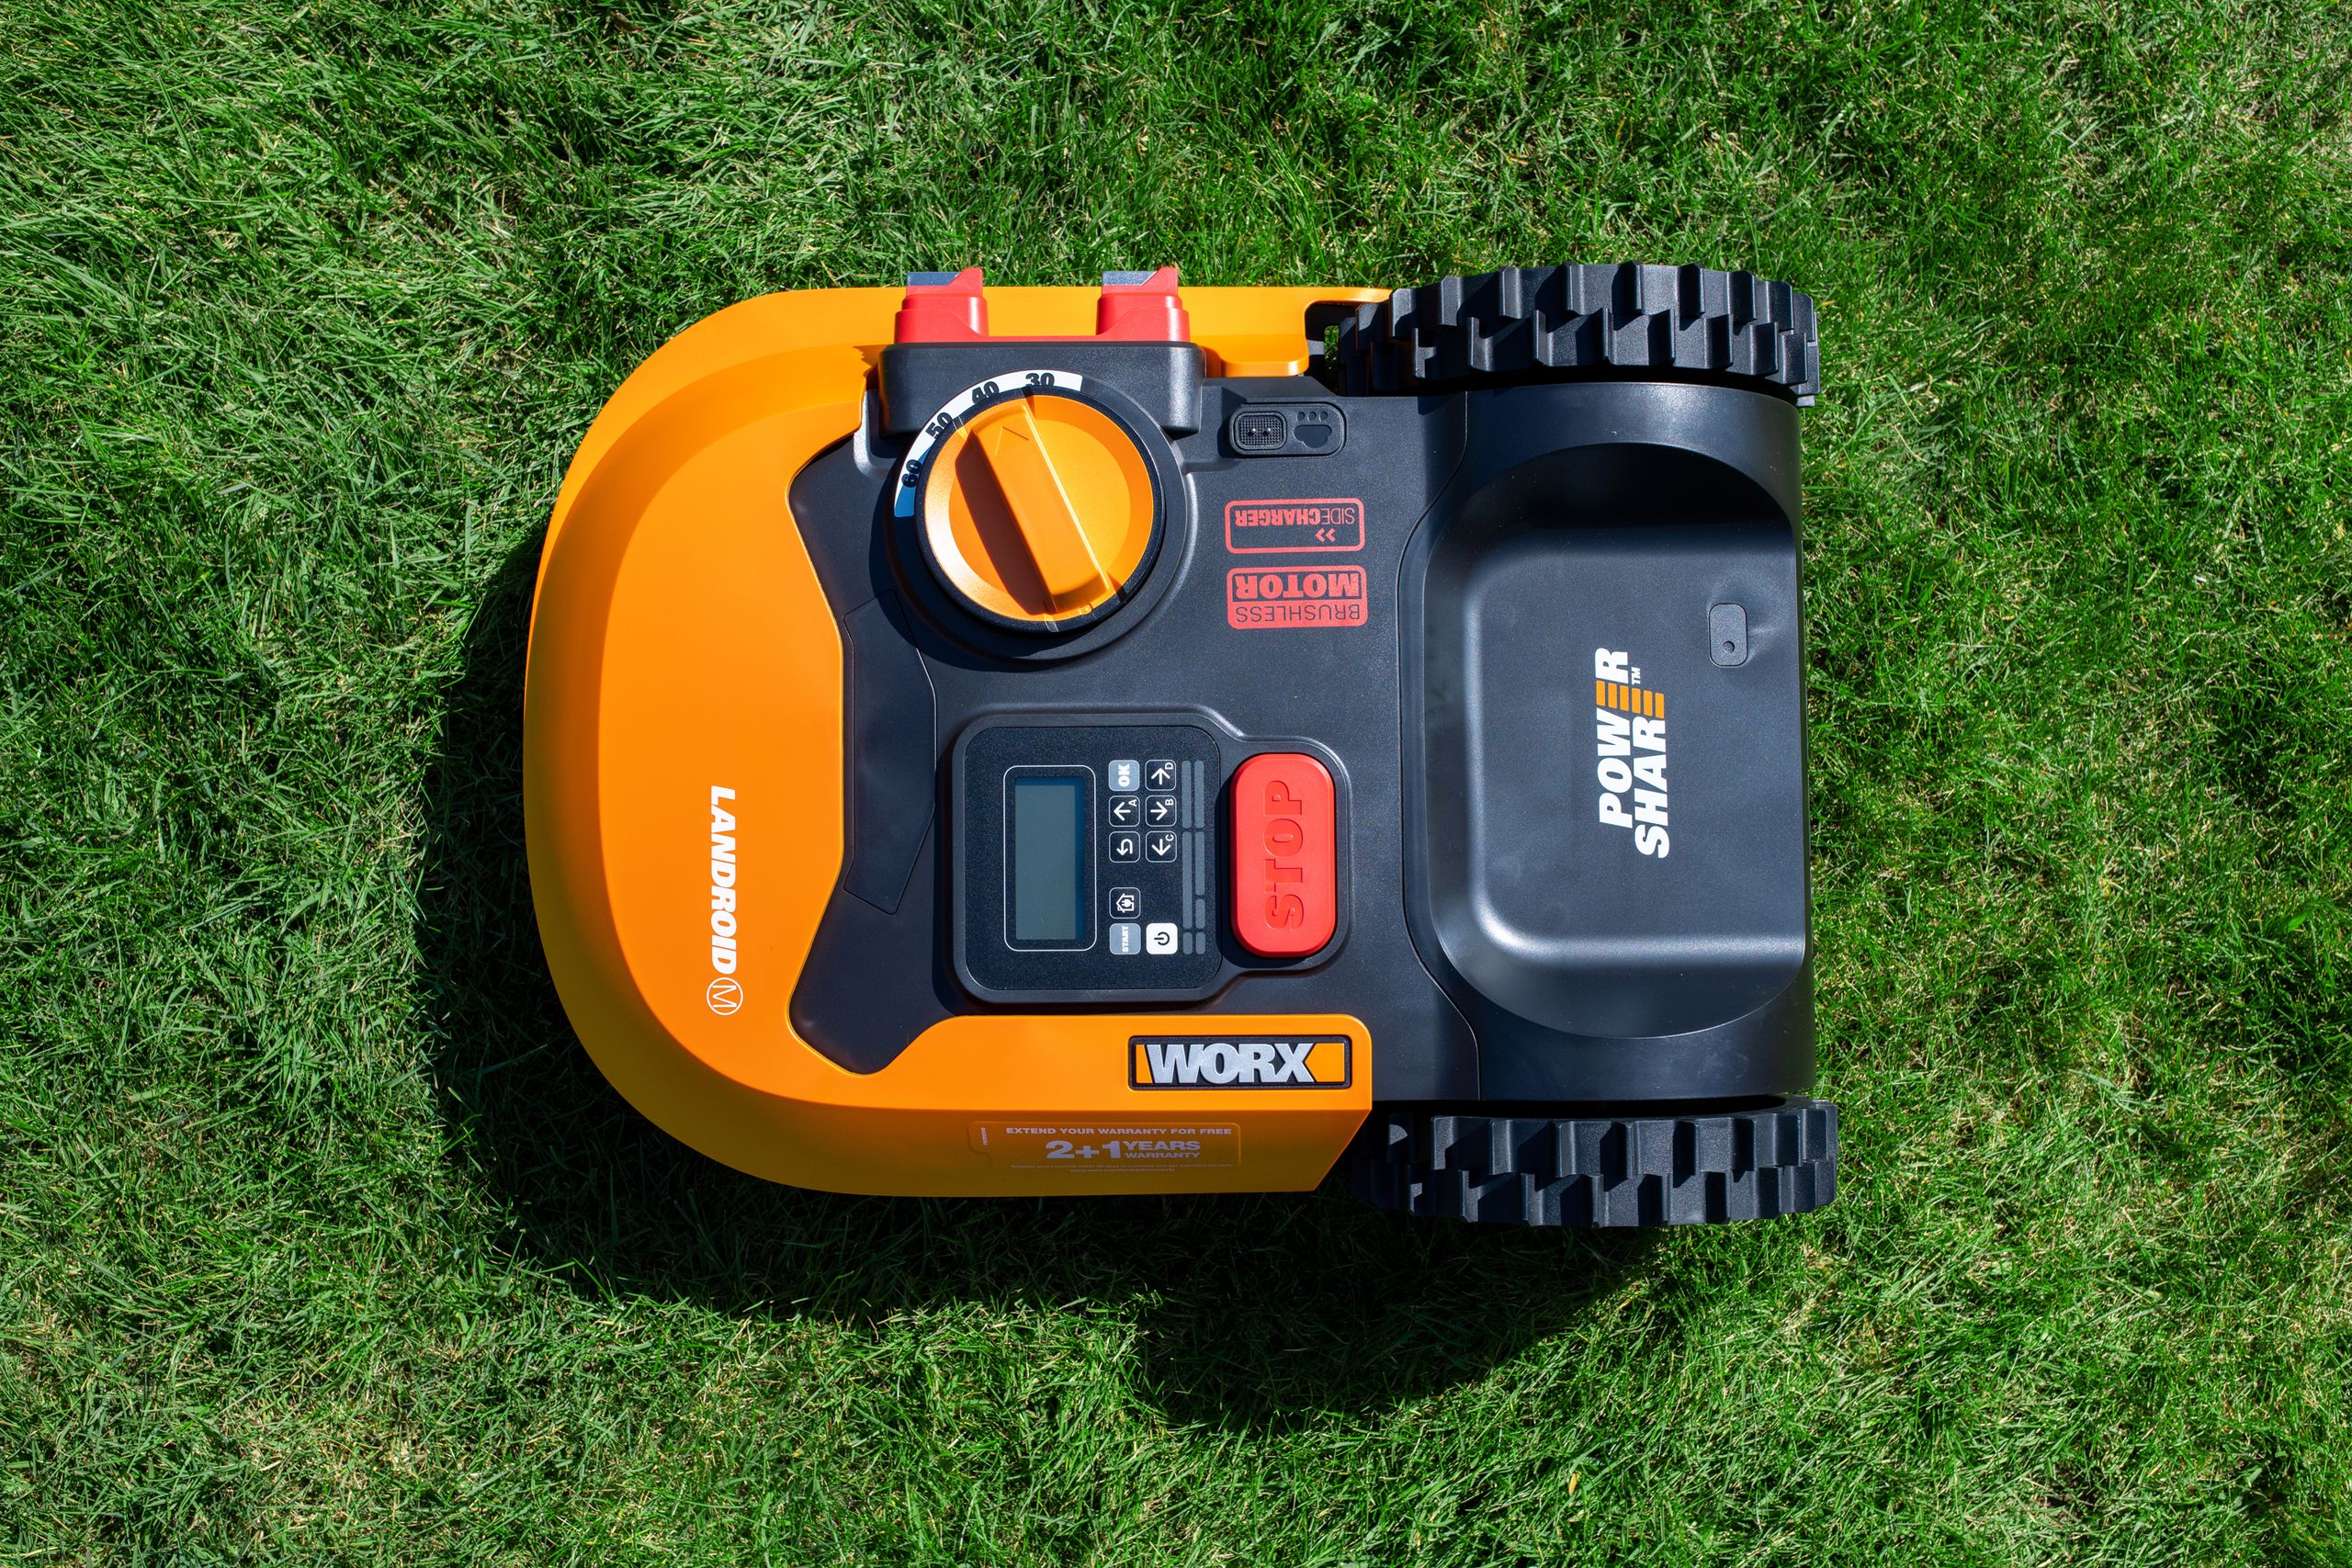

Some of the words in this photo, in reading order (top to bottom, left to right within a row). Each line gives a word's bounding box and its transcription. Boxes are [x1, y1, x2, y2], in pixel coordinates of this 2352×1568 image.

[1025, 372, 1056, 387] 30
[971, 380, 1000, 404] 40
[925, 412, 954, 439] 50
[901, 459, 922, 488] 60
[1235, 507, 1355, 527] SIDECHARGER
[1235, 573, 1360, 599] MOTOR
[1236, 604, 1360, 623] BRUSHLESS
[1118, 763, 1131, 787] OK
[1165, 761, 1173, 770] D
[1128, 798, 1137, 807] A
[1165, 833, 1174, 841] C
[1263, 780, 1305, 931] STOP
[710, 785, 737, 975] LANDROID
[1147, 1043, 1316, 1084] WORX
[1046, 1140, 1121, 1159] 2+1
[1123, 1141, 1201, 1151] YEARS
